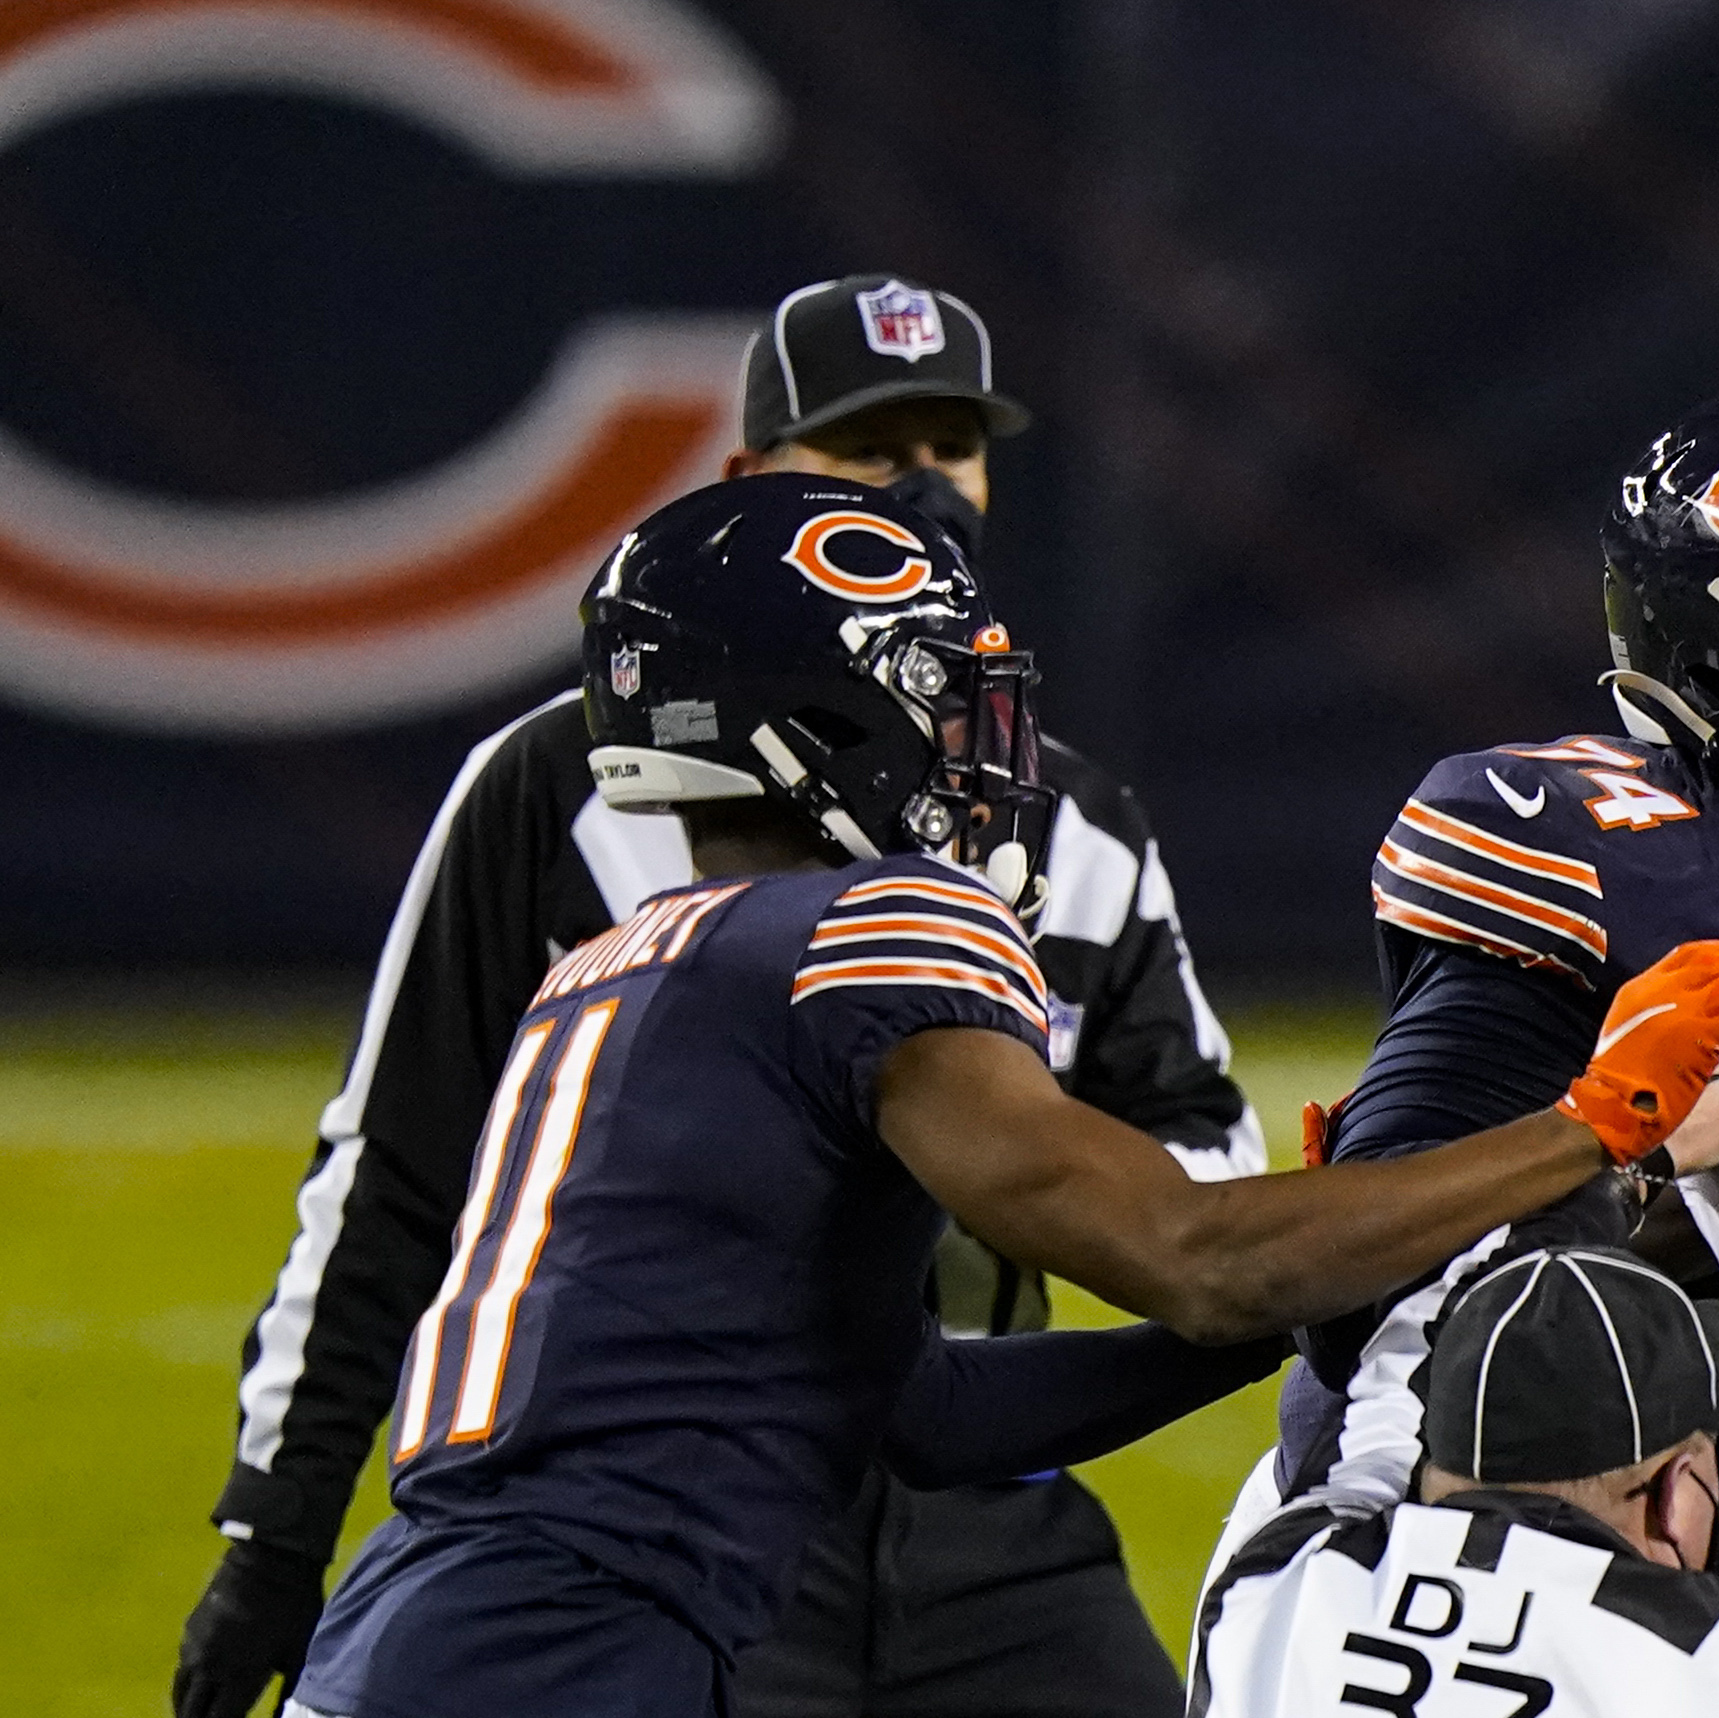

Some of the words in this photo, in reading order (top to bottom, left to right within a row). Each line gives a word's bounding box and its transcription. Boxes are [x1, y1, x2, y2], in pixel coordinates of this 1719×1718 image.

[1495, 736, 1701, 832] 74
[395, 997, 621, 1464] 11
[1389, 1573, 1534, 1656] DJ
